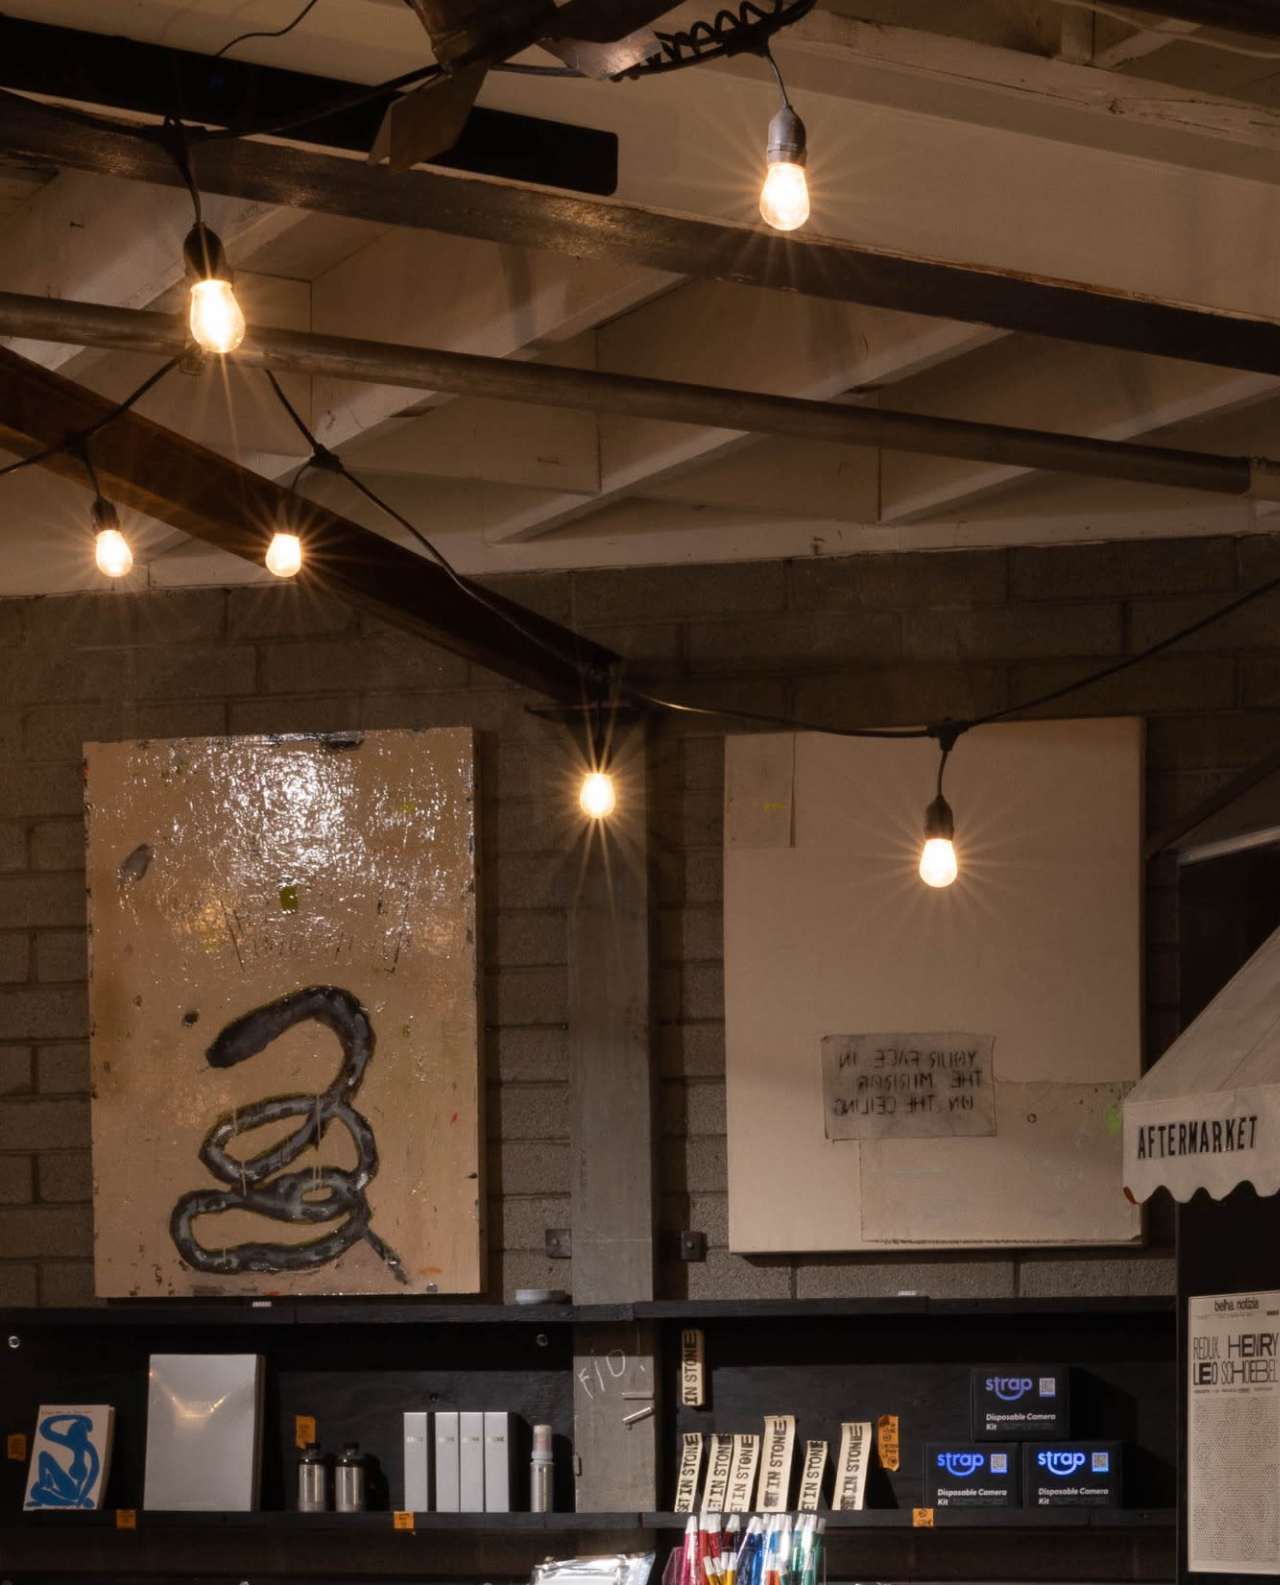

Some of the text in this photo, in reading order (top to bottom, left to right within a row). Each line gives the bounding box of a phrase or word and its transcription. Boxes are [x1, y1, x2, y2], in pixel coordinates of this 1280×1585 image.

[1136, 1115, 1258, 1160] AFTERMARKET
[684, 1329, 698, 1404] IN STONE
[985, 1376, 1033, 1401] strap
[986, 1412, 1056, 1422] Disposable Camera
[986, 1422, 997, 1431] Kit
[770, 1418, 788, 1468] STONE
[846, 1424, 864, 1473] STONE
[682, 1434, 699, 1478] STONE
[736, 1435, 754, 1479] STONE
[806, 1440, 824, 1478] STONE
[936, 1452, 985, 1477] strap
[1037, 1450, 1086, 1476] strap
[937, 1488, 1007, 1498] Disposable Camera
[937, 1498, 949, 1506] Kit
[1038, 1487, 1109, 1497] Disposable Camera
[1038, 1497, 1050, 1505] Kit
